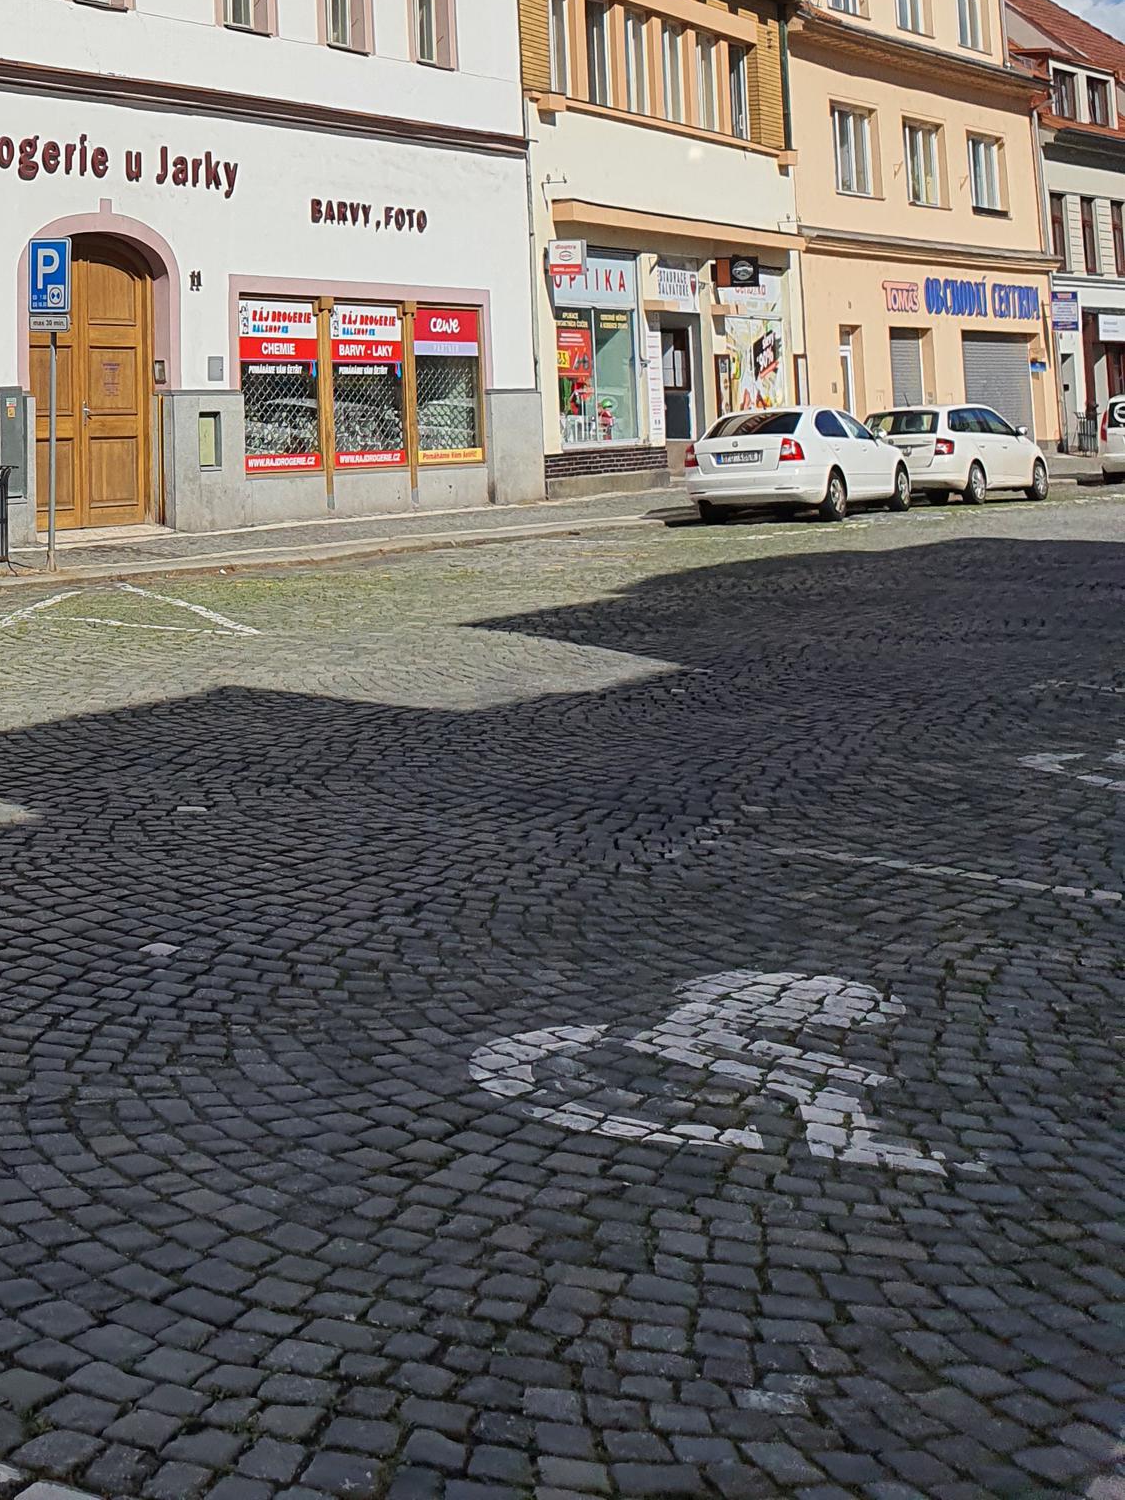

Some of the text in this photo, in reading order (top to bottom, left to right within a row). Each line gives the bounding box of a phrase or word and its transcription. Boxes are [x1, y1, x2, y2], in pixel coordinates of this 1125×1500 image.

[125, 150, 142, 182] u
[156, 146, 239, 198] Jarky
[310, 198, 372, 228] BARVY
[37, 248, 60, 290] P
[554, 267, 626, 292] OPTIKA
[925, 275, 988, 318] OBCHODNÍ
[992, 283, 1041, 320] CENTRUM
[261, 342, 295, 355] CHEMIE
[339, 344, 365, 356] BARVY
[372, 345, 393, 356] LAKY
